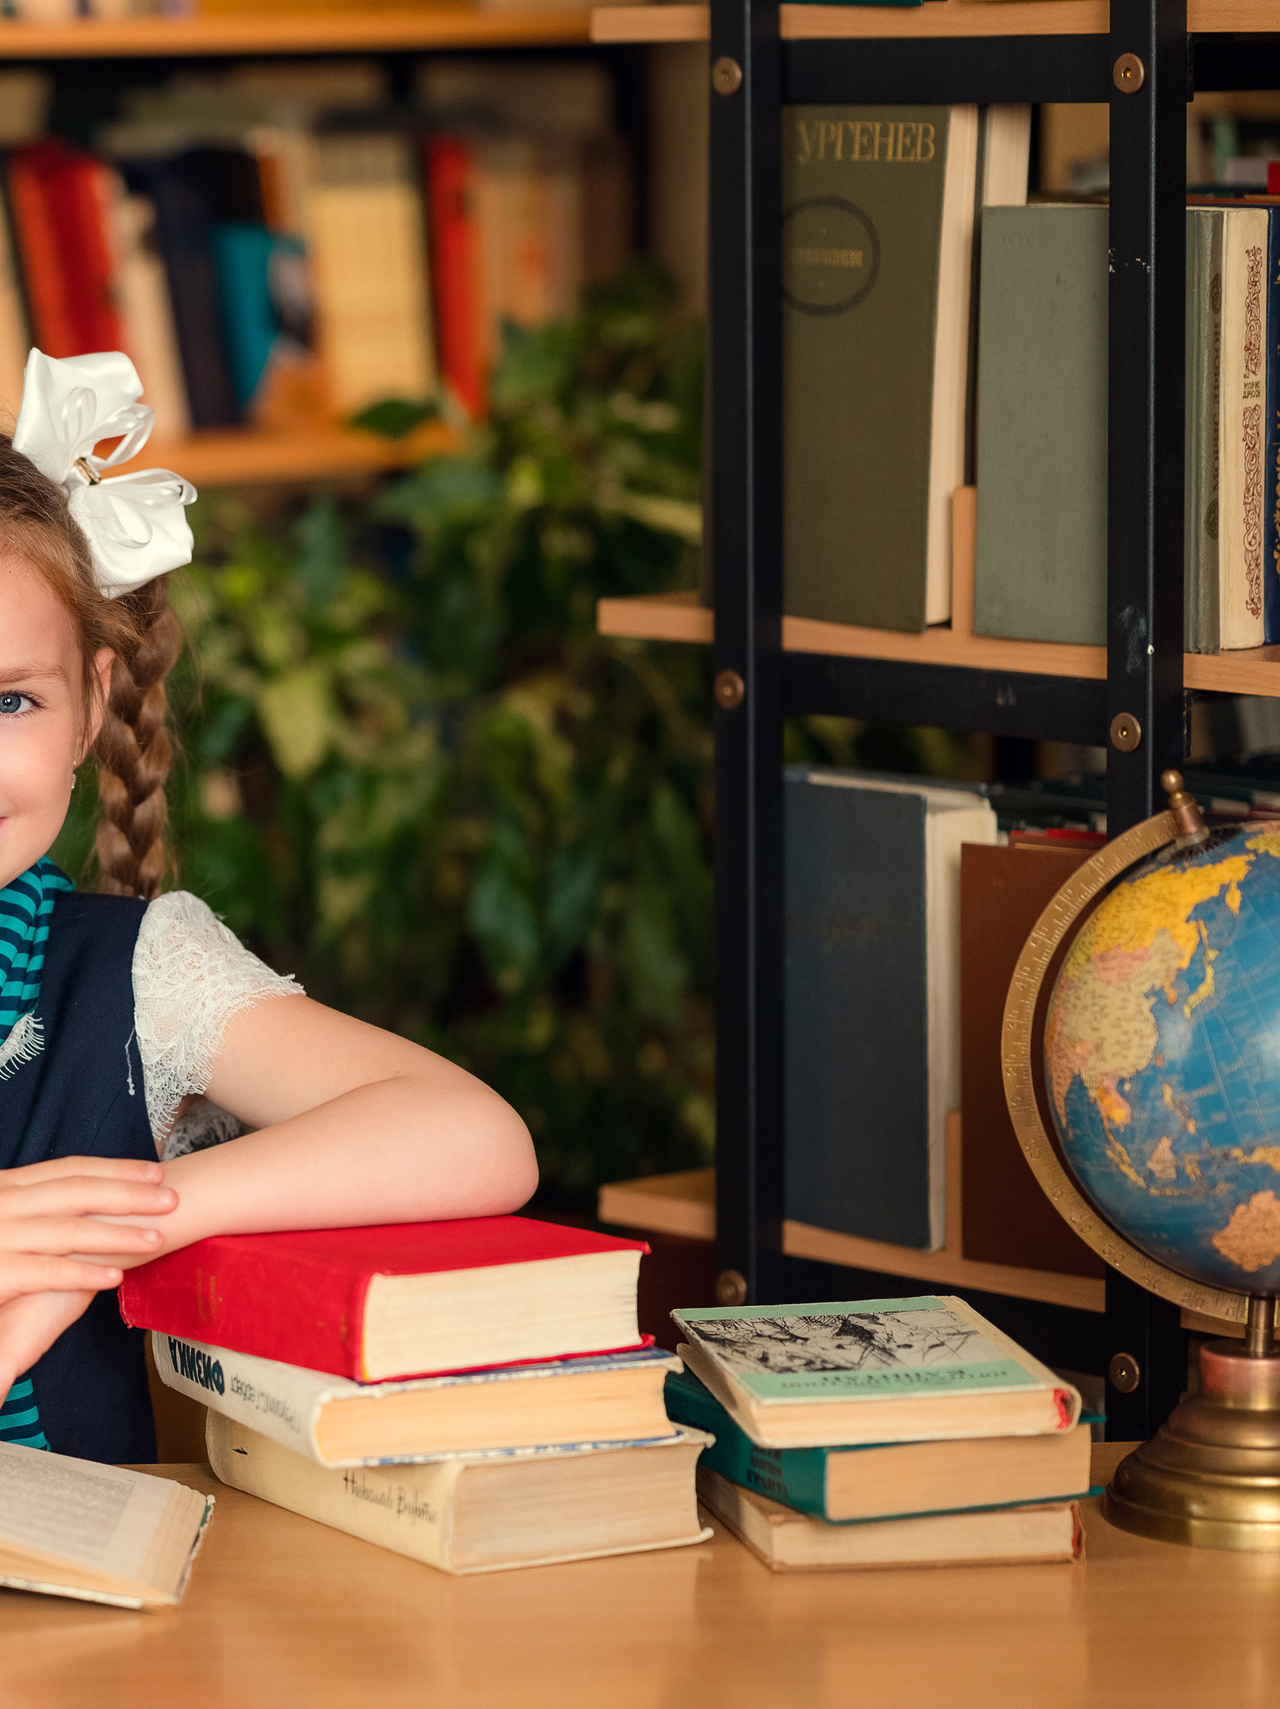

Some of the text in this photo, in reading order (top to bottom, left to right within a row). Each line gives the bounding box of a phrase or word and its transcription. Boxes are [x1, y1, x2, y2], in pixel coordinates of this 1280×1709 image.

[796, 119, 937, 163] УРГЕНЕВ
[1014, 966, 1032, 991] 40
[167, 1335, 226, 1397] ФИЗИКА
